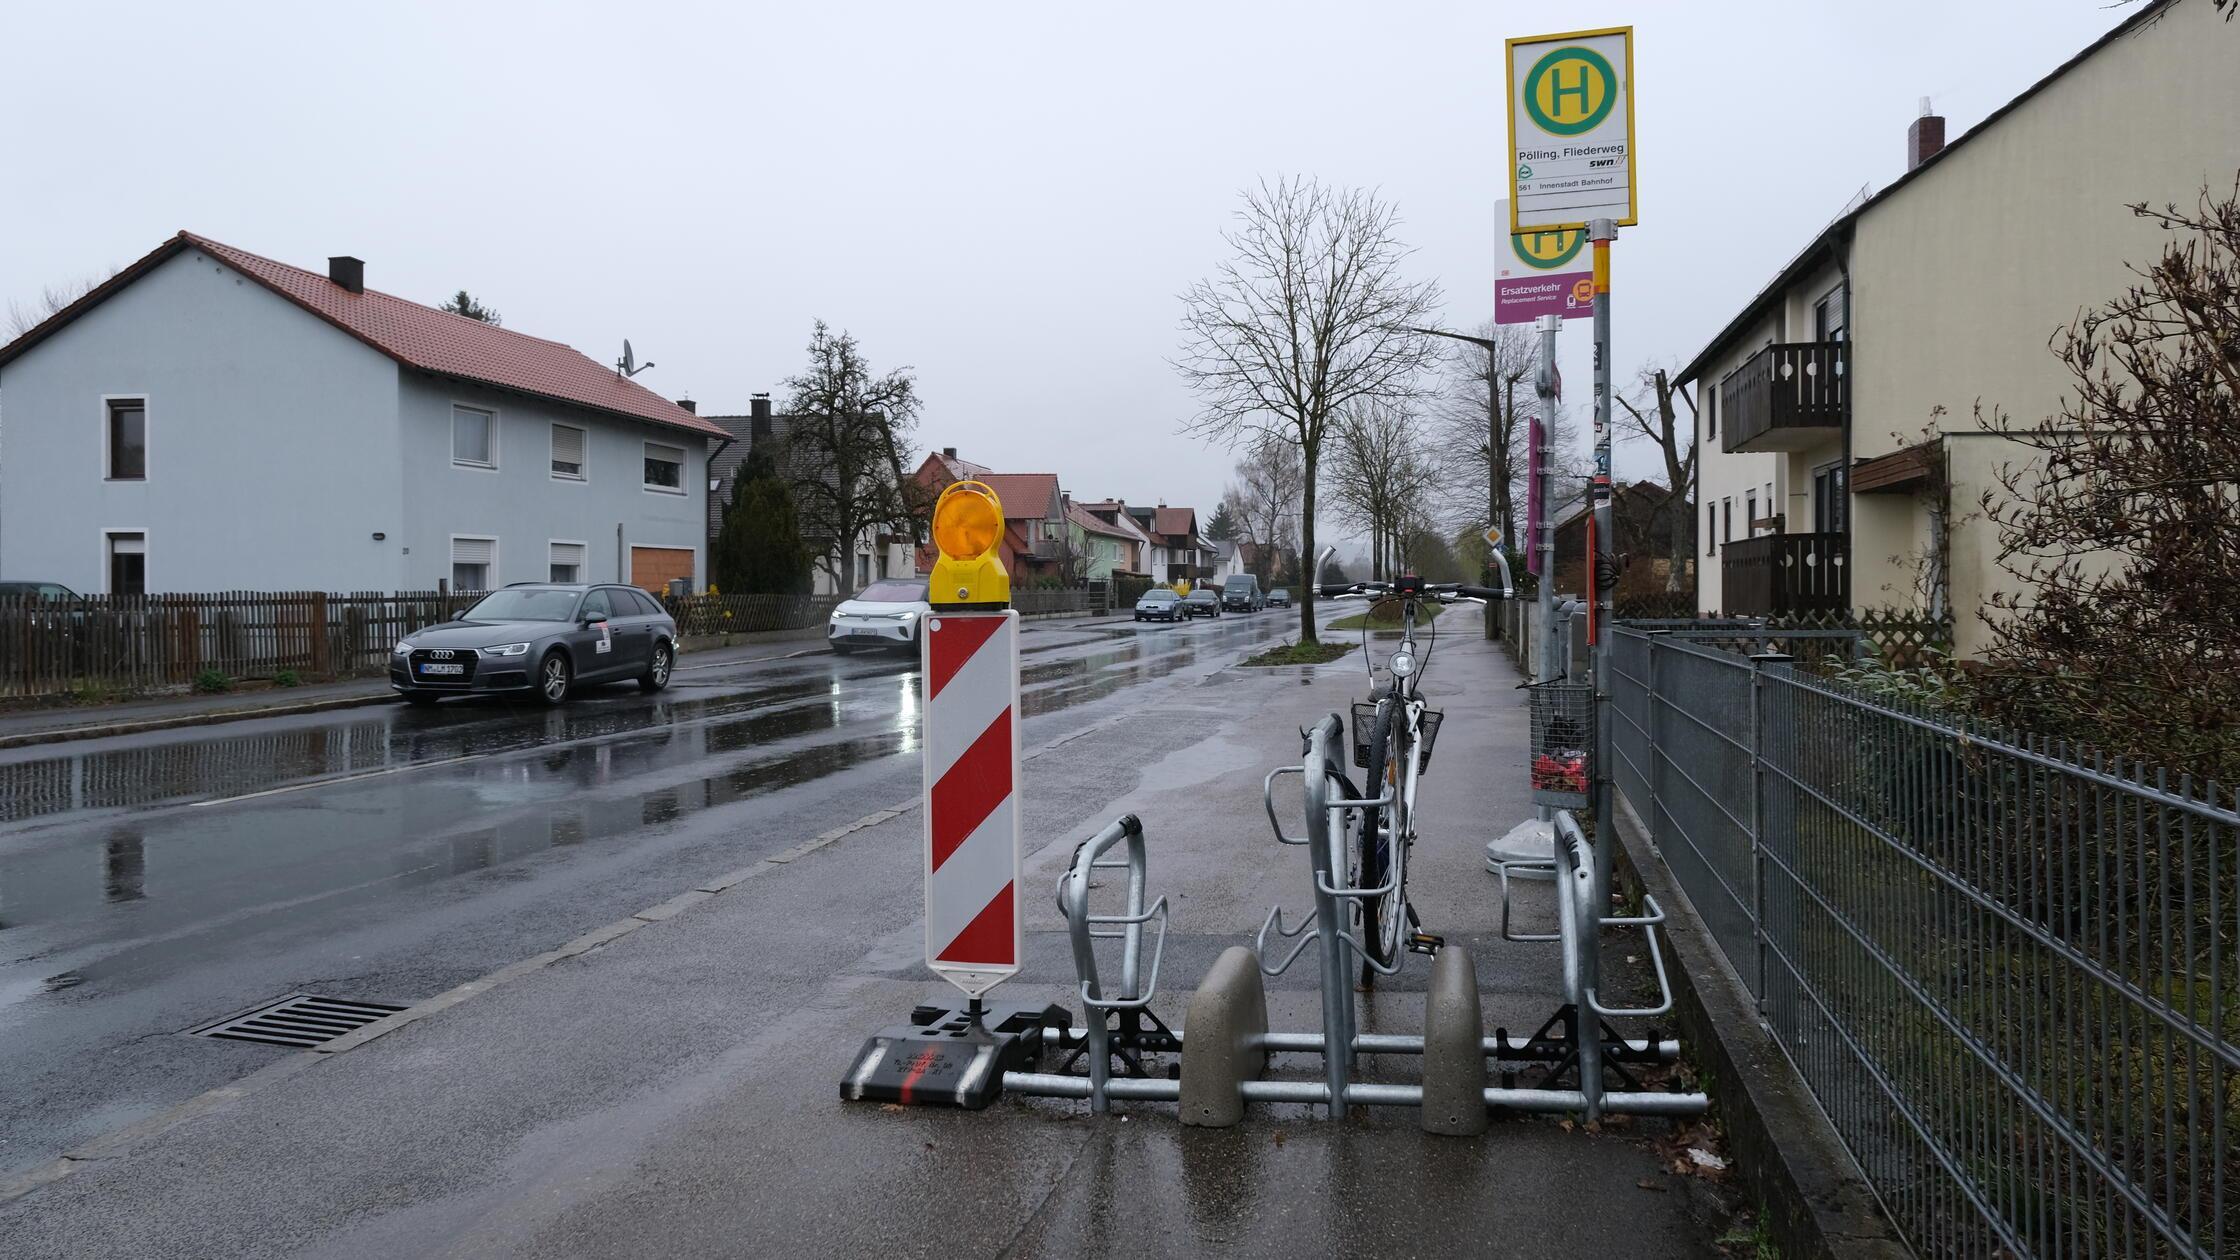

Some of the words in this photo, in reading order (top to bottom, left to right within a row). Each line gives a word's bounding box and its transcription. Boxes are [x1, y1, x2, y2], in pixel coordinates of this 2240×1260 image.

[1552, 65, 1589, 117] H
[1519, 150, 1560, 161] Pölling,
[1563, 144, 1624, 157] Fliederweg
[1589, 159, 1614, 168] swn
[1518, 184, 1531, 192] 561
[1539, 180, 1579, 190] Innenstadt
[1581, 177, 1613, 187] Bahnhof
[1501, 283, 1561, 296] Ersatzverkehr
[1501, 296, 1536, 305] Replacement
